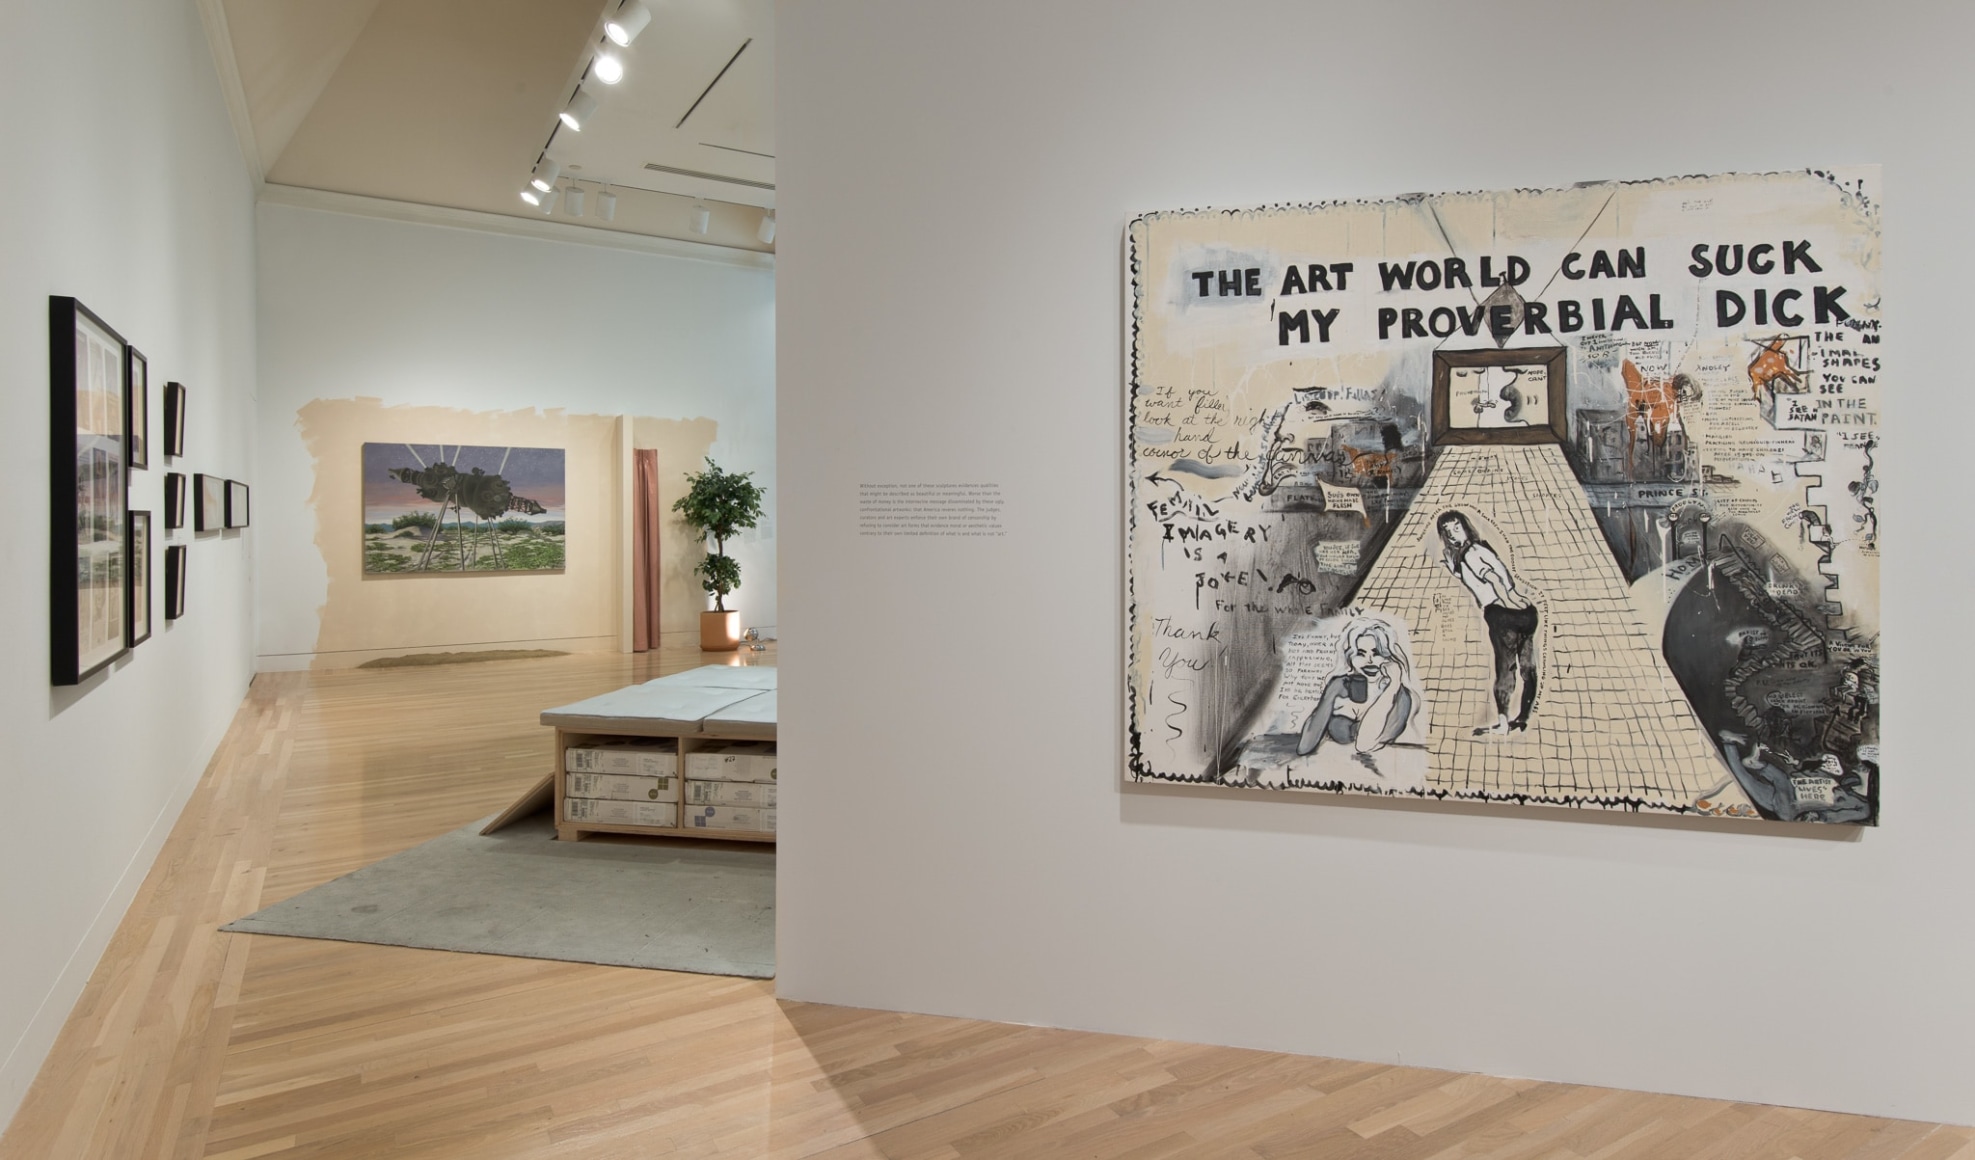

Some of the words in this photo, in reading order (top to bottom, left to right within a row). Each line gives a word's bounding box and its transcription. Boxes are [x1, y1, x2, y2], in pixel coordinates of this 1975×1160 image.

[1192, 268, 1262, 296] THE
[1280, 263, 1354, 296] ART
[1378, 256, 1530, 292] WORLD
[1562, 246, 1646, 280] CAN
[1688, 240, 1822, 278] SUCK
[1279, 309, 1340, 345] MY
[1378, 294, 1674, 340] PROVERBIAL
[1716, 286, 1850, 328] DICK
[1823, 358, 1880, 372] SHAPES
[1823, 374, 1846, 382] YOU
[1188, 388, 1218, 401] you
[1820, 384, 1843, 394] SEE
[1145, 397, 1184, 407] want
[1816, 399, 1832, 409] IN
[1837, 398, 1867, 409] THE
[1143, 411, 1175, 426] look
[1182, 414, 1196, 425] at
[1204, 413, 1227, 426] the
[1174, 427, 1218, 443] hand
[1198, 444, 1222, 464] of
[1224, 441, 1256, 460] the
[1638, 489, 1683, 498] PRINCE
[1162, 520, 1271, 543] IMAGERY
[1184, 547, 1202, 561] IS
[1217, 552, 1227, 564] A
[1155, 616, 1222, 643] Thank
[1158, 647, 1210, 679] You
